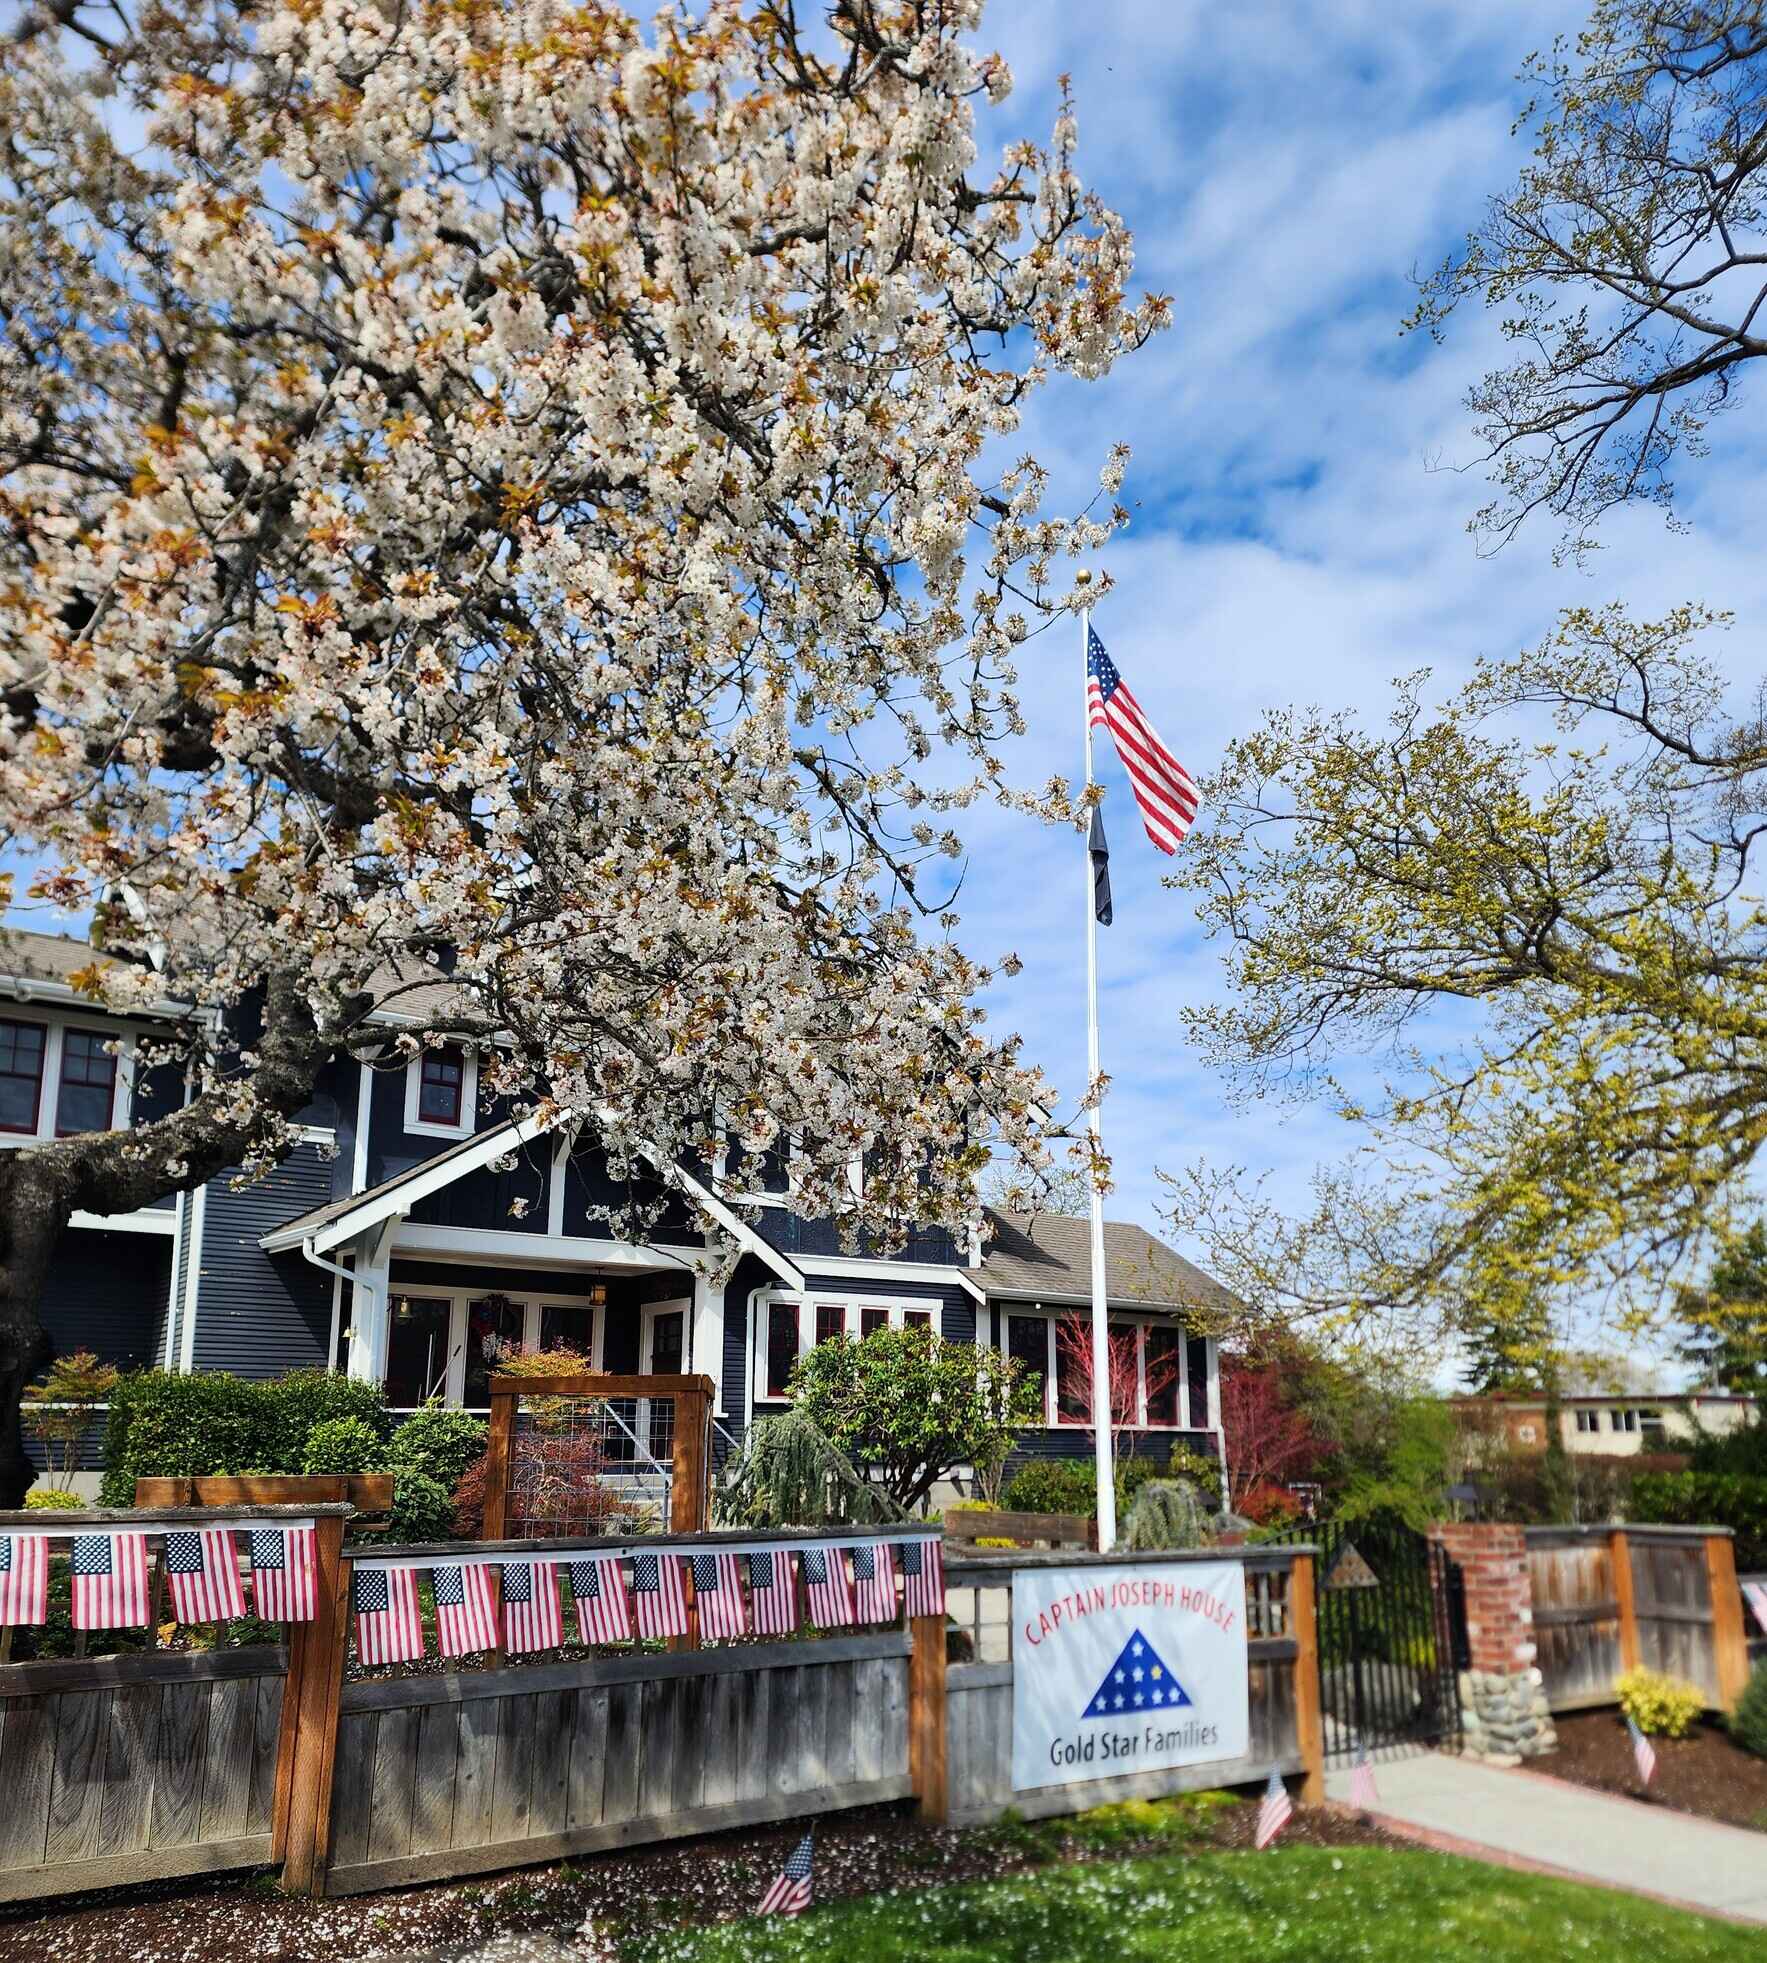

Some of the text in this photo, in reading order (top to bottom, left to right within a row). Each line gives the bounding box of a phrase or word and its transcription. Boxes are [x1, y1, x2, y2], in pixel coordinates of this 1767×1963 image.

[1025, 1581, 1236, 1645] CAPTAIN JOSEPH HOUSE
[1051, 1722, 1218, 1766] Gold Star Families
